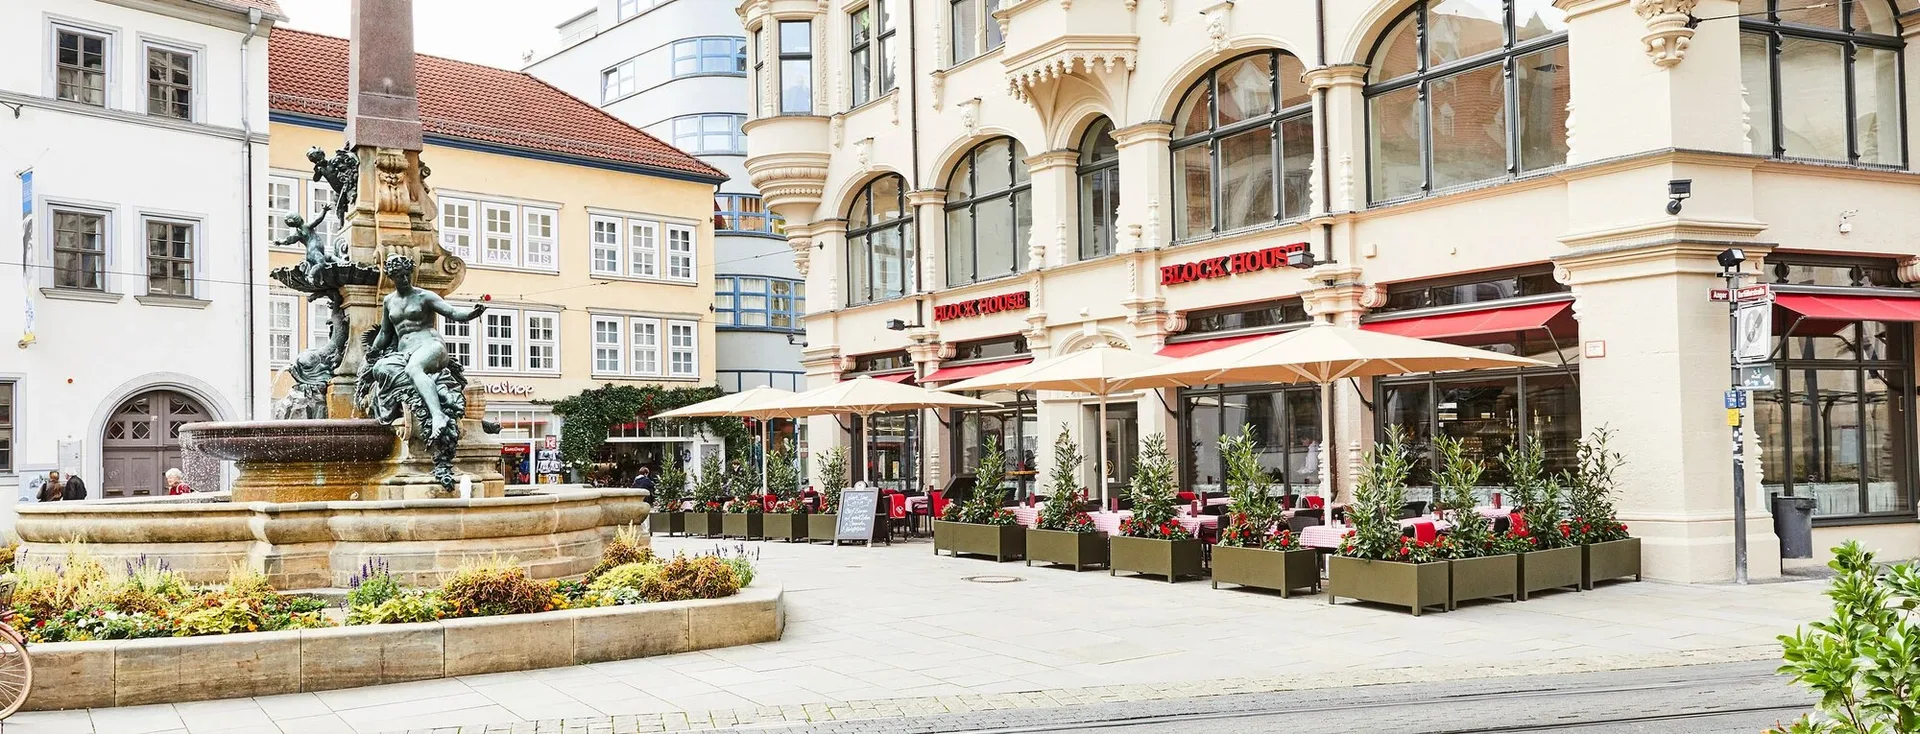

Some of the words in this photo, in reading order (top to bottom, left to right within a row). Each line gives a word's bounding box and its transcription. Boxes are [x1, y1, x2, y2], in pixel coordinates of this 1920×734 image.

[1161, 256, 1230, 285] BLOCK
[934, 299, 977, 322] BLOCK
[979, 291, 1028, 314] HOUSE
[1713, 290, 1727, 299] Anger
